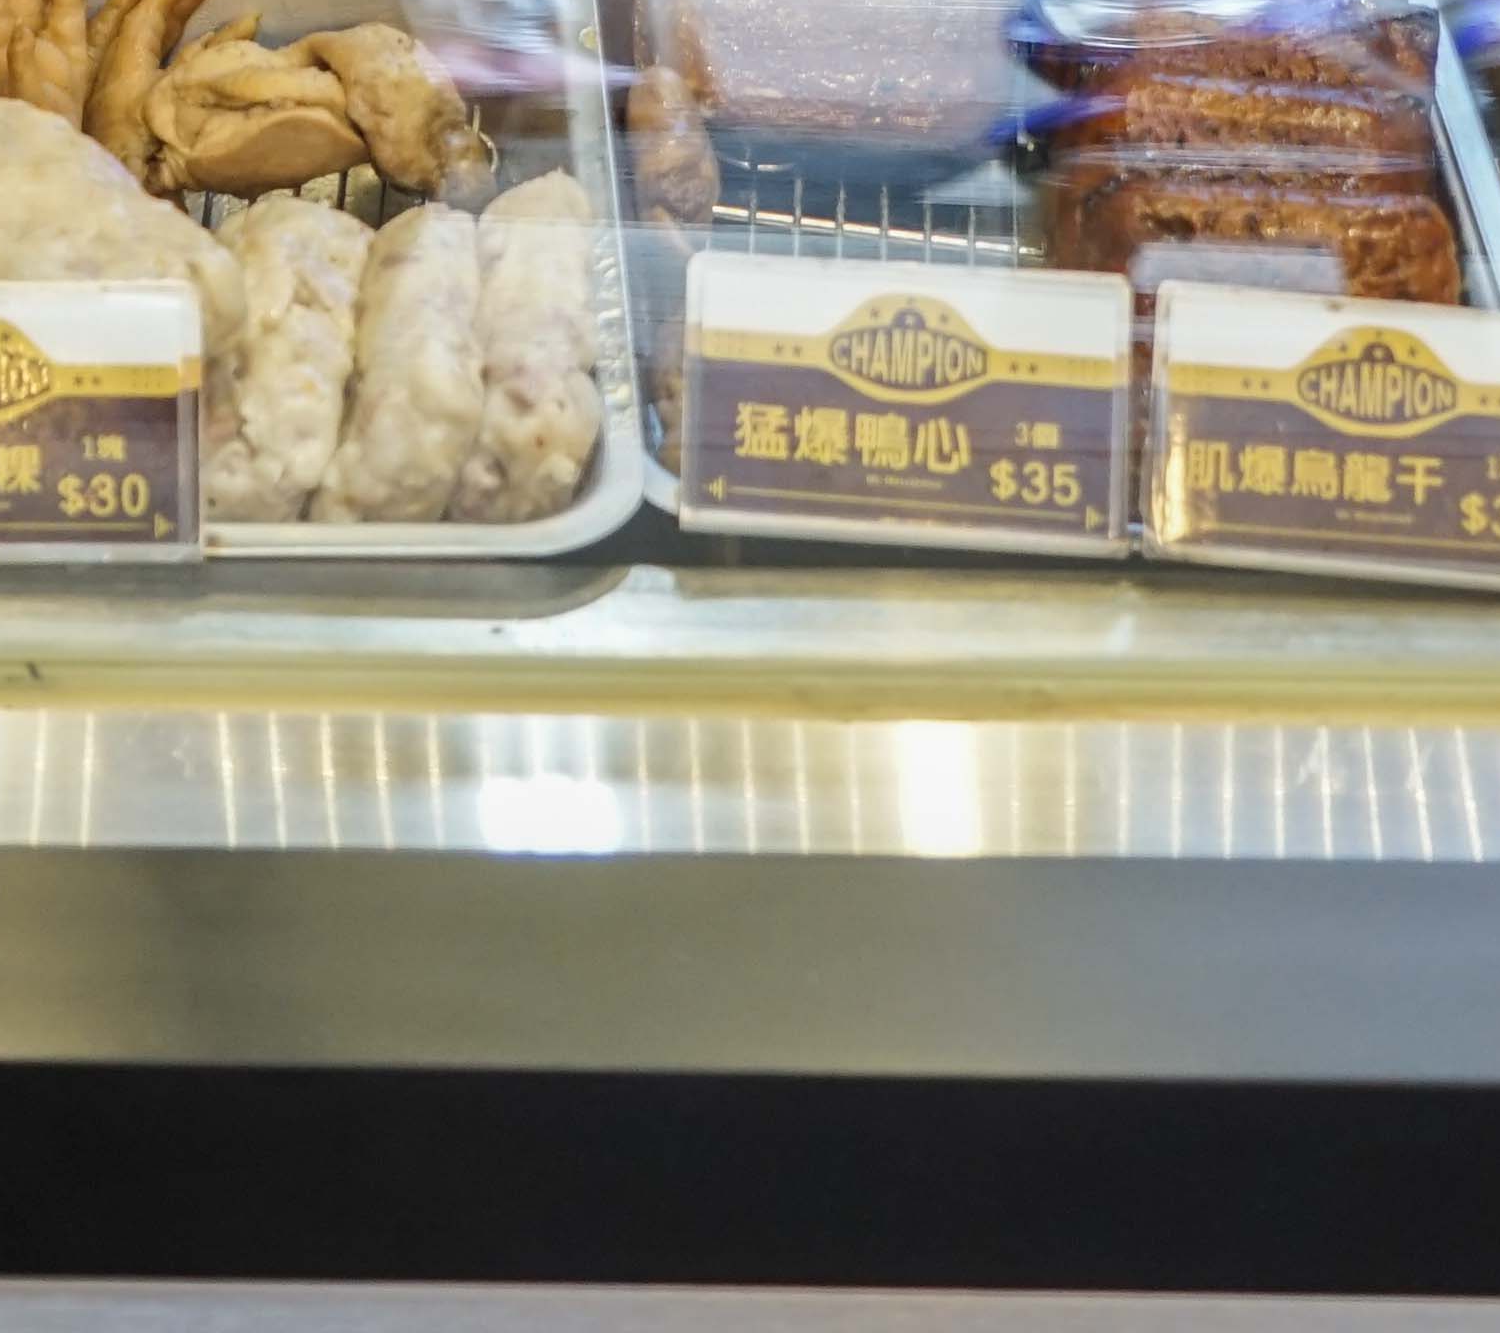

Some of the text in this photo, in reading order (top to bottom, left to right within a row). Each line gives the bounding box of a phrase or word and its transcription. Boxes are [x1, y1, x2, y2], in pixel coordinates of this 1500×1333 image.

[831, 327, 986, 387] CHAMPION
[1300, 360, 1456, 423] CHAMPION
[734, 400, 974, 475] 猛爆鴨心
[56, 471, 151, 517] $30
[988, 458, 1083, 508] $35
